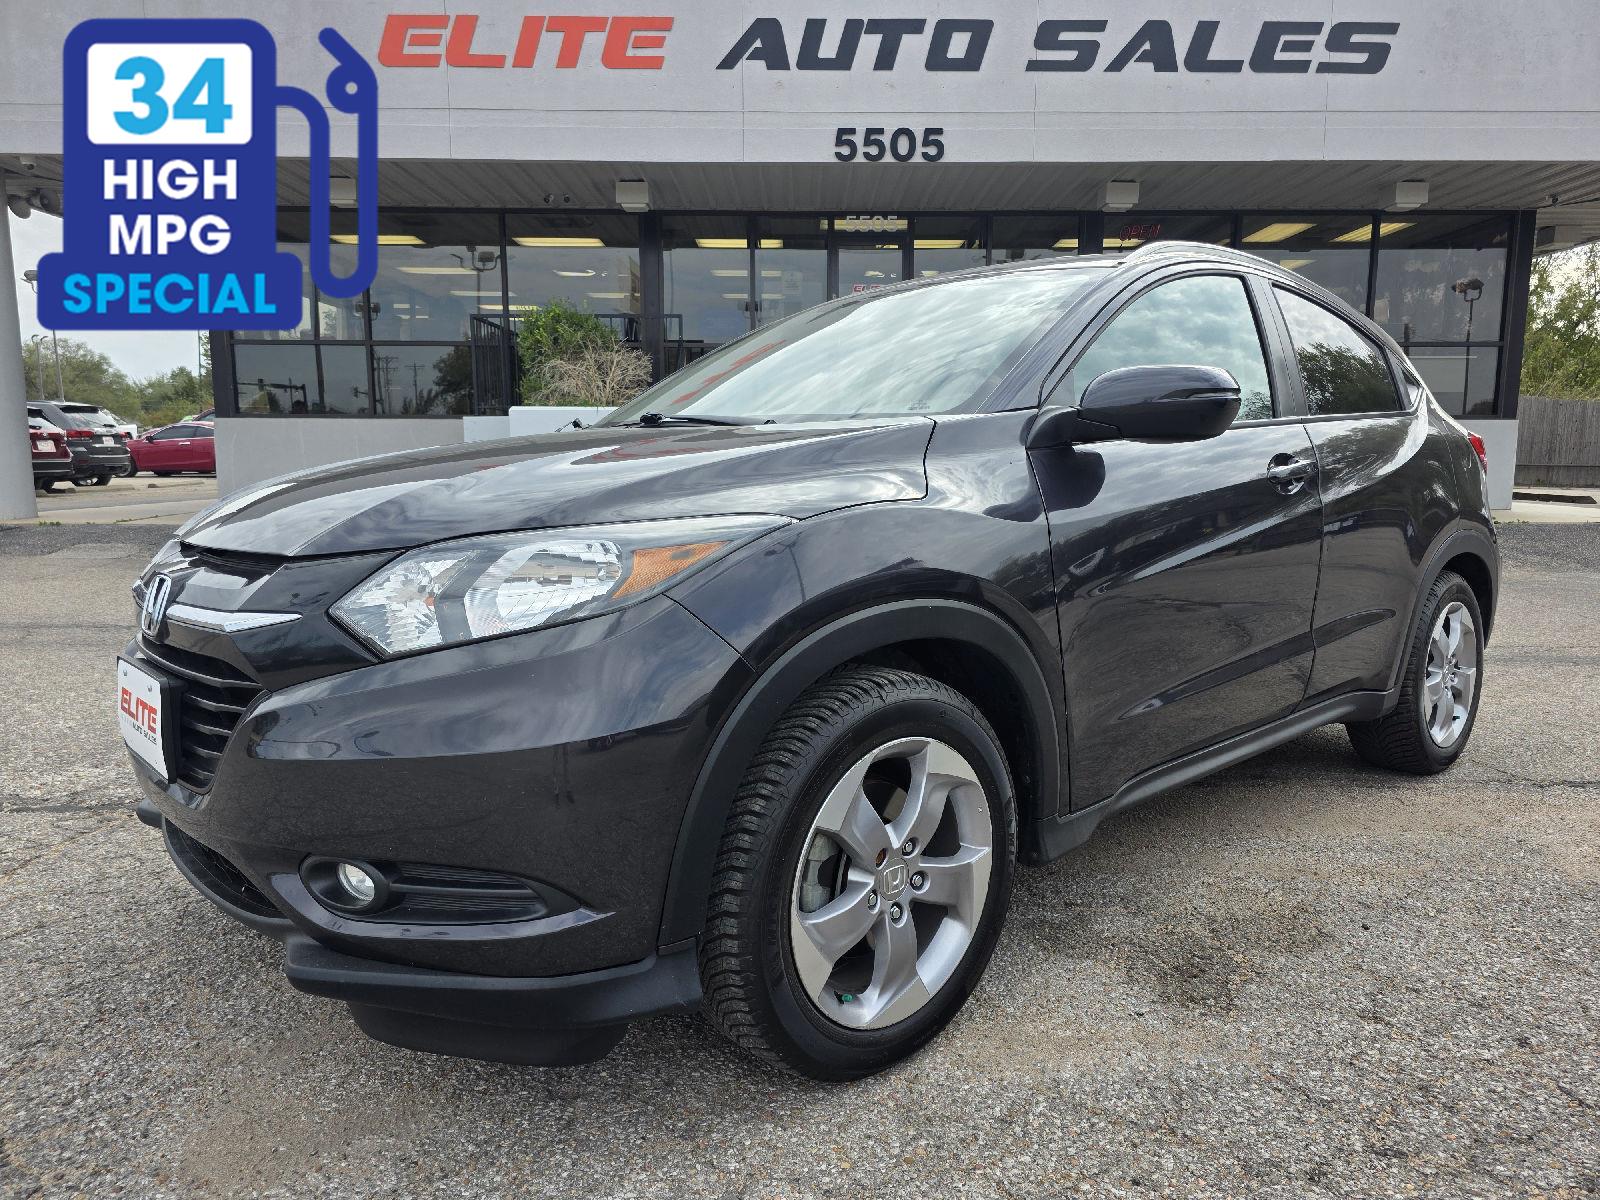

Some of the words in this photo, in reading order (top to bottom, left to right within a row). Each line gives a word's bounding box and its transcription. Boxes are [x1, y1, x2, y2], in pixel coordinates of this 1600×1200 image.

[378, 14, 674, 69] ELITE
[716, 17, 994, 72] AUTO
[1025, 19, 1401, 75] SALES
[834, 127, 945, 162] 5505
[845, 215, 898, 232] 5505
[1119, 223, 1161, 241] OPEN
[121, 686, 158, 735] ELITE
